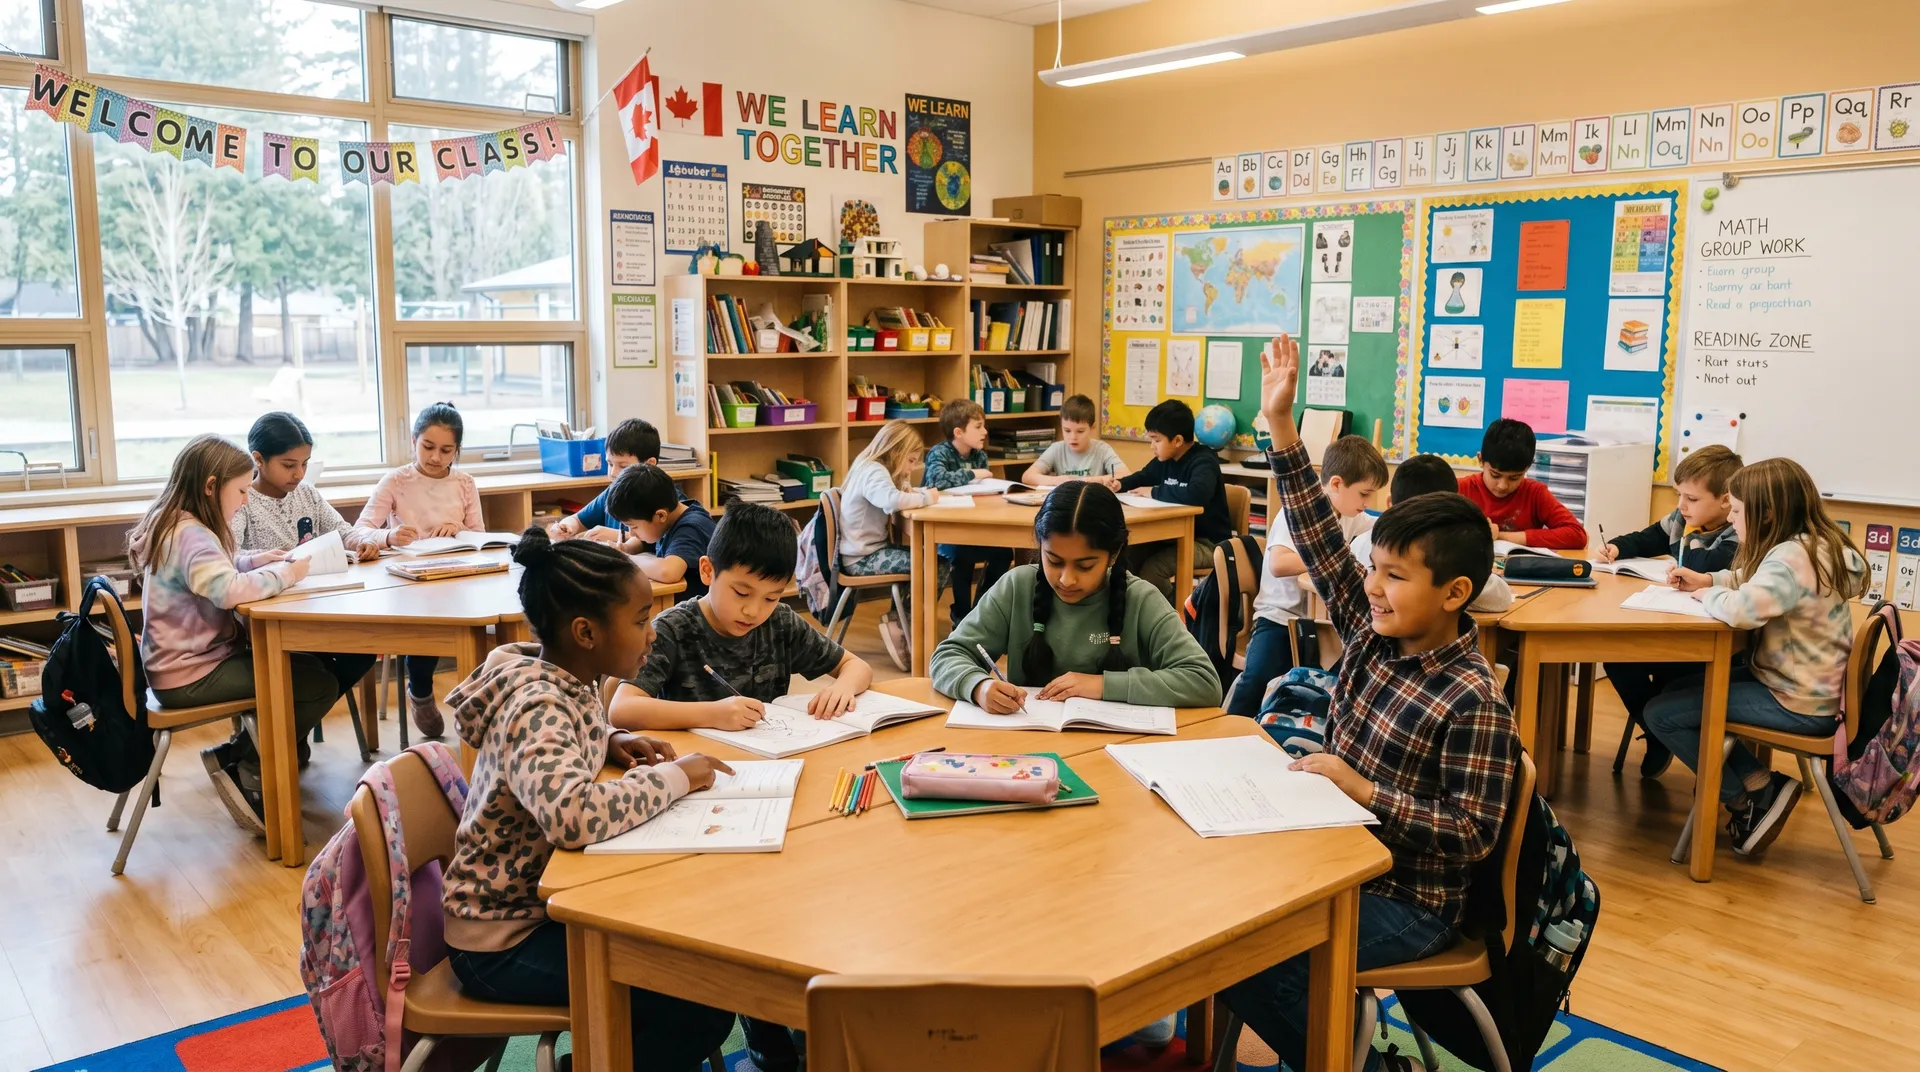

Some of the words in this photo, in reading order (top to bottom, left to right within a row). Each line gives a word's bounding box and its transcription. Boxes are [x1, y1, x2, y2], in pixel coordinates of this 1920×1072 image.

[908, 97, 927, 113] WE
[930, 101, 969, 118] LEARN
[1835, 98, 1867, 118] Qq
[1890, 92, 1912, 109] Rr
[736, 91, 787, 127] WE
[802, 99, 896, 140] LEARN
[1700, 112, 1724, 128] Nn
[1743, 108, 1770, 123] Oo
[1791, 103, 1814, 123] Pp
[34, 73, 239, 160] WELCOME
[268, 142, 317, 171] TO
[343, 149, 415, 174] OUR
[436, 125, 557, 171] CLASS!
[1624, 120, 1637, 135] Ll
[1656, 116, 1686, 132] Mm
[1513, 131, 1524, 146] Ll
[1541, 128, 1568, 143] Mm
[1585, 124, 1599, 139] Ik
[1444, 137, 1456, 156] Jj
[1476, 135, 1492, 149] Kk
[1700, 138, 1722, 153] Nn
[1741, 133, 1768, 148] Oo
[736, 128, 898, 174] TOGETHER
[1350, 148, 1366, 162] Hh
[1383, 145, 1395, 158] In
[1414, 142, 1423, 160] Ij
[1617, 144, 1639, 159] Nn
[1657, 141, 1683, 160] Oq
[1243, 159, 1257, 171] Bb
[1268, 156, 1282, 169] Cc
[1295, 153, 1310, 167] Df
[1322, 151, 1339, 167] Gg
[1475, 157, 1492, 171] Kk
[1540, 152, 1567, 166] Mm
[1217, 162, 1231, 173] Aa
[1351, 168, 1364, 182] Ff
[1379, 167, 1397, 183] Gg
[1409, 164, 1426, 177] Hn
[1443, 161, 1455, 179] Jj
[1293, 173, 1310, 187] Dd
[1323, 172, 1336, 185] Ee
[1719, 218, 1768, 236] MATH
[1701, 241, 1751, 257] GROUP
[1760, 238, 1805, 254] WORK
[1742, 266, 1775, 279] group
[1707, 298, 1730, 309] Read
[1694, 331, 1761, 347] READING
[1769, 333, 1812, 348] ZONE
[1704, 373, 1729, 384] Nnot
[1737, 374, 1757, 386] out
[1868, 531, 1889, 545] 3d
[1900, 535, 1920, 549] 3d
